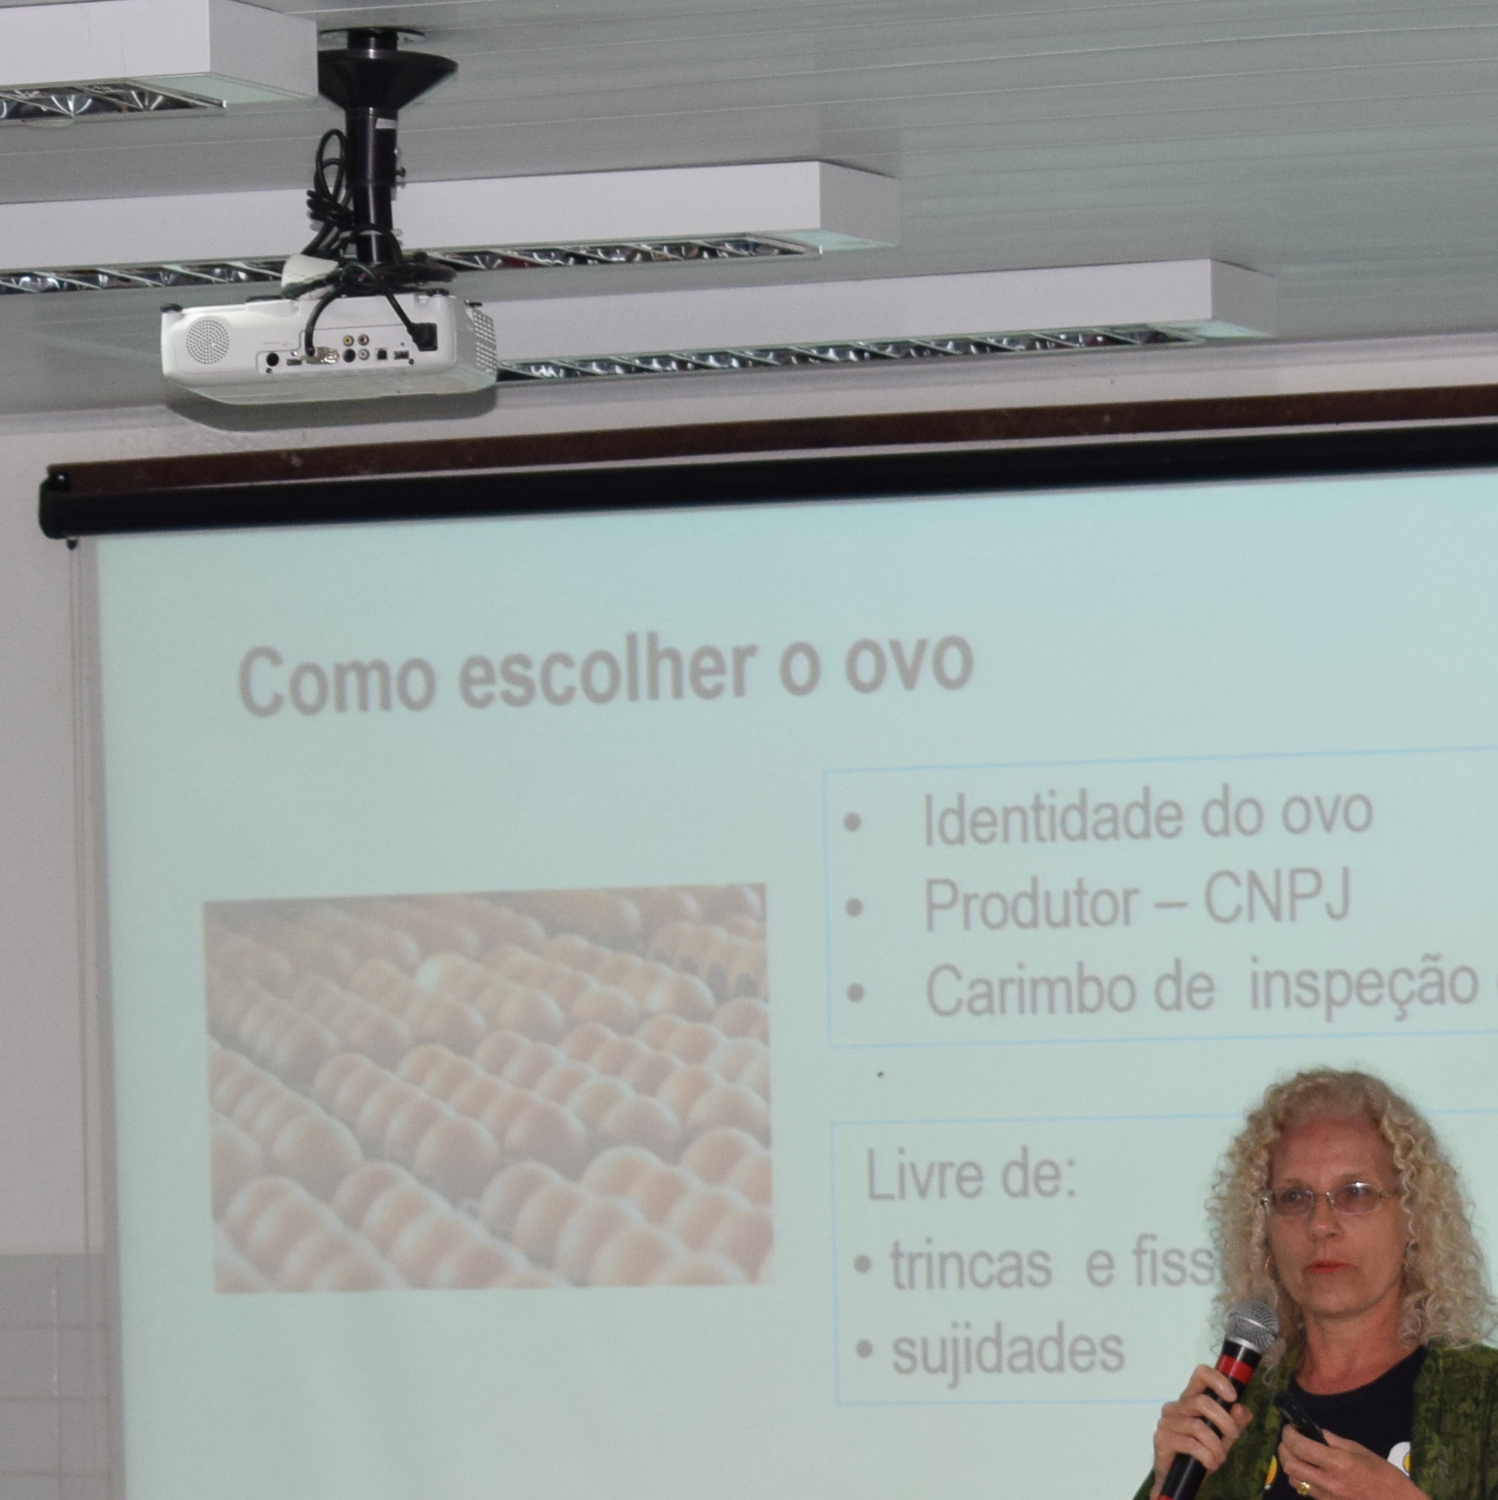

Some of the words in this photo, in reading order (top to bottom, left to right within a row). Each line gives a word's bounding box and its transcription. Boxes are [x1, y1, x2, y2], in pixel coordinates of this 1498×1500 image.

[238, 645, 437, 719] Como
[459, 631, 758, 710] escolher
[779, 641, 822, 697] o
[845, 635, 974, 694] ovo
[925, 785, 1185, 847] Identidade
[1201, 783, 1265, 838] do
[1281, 793, 1374, 836] ovo
[925, 875, 1140, 932] Produtor
[1204, 866, 1351, 925] CNPJ
[926, 960, 1137, 1018] Carimbo
[1153, 957, 1216, 1013] de
[1250, 953, 1480, 1023] inspeção
[867, 1147, 985, 1202] Livre
[1001, 1145, 1076, 1199] de:
[889, 1236, 1053, 1291] trincas
[1085, 1249, 1117, 1288] e
[1132, 1231, 1216, 1288] fiss
[892, 1320, 1126, 1390] sujidades
